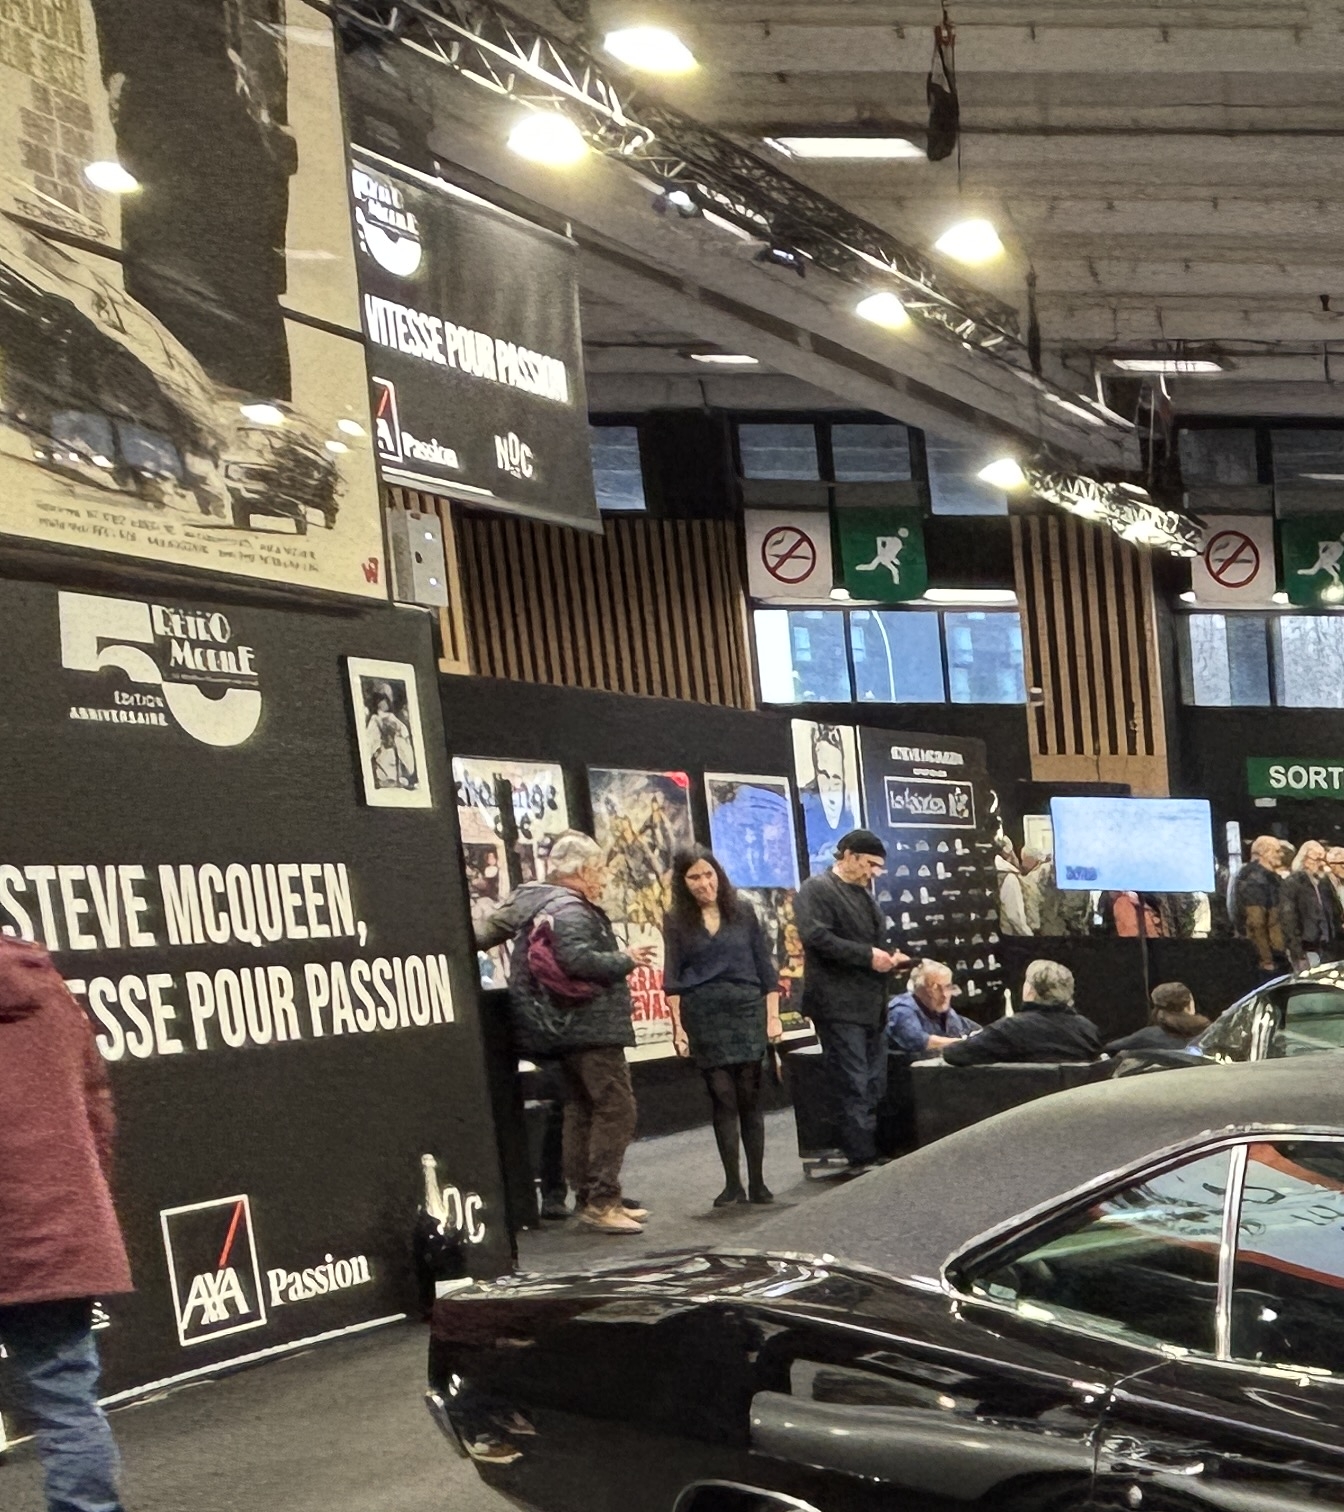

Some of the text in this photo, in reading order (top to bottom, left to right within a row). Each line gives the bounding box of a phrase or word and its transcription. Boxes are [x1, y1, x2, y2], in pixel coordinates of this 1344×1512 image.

[365, 294, 569, 404] VITESSE POUR PASSION
[0, 862, 369, 951] STEVE MCQUEEN,
[185, 965, 301, 1051] POUR
[303, 954, 455, 1037] PASSION
[178, 1267, 254, 1330] AXA
[266, 1253, 371, 1308] Passion
